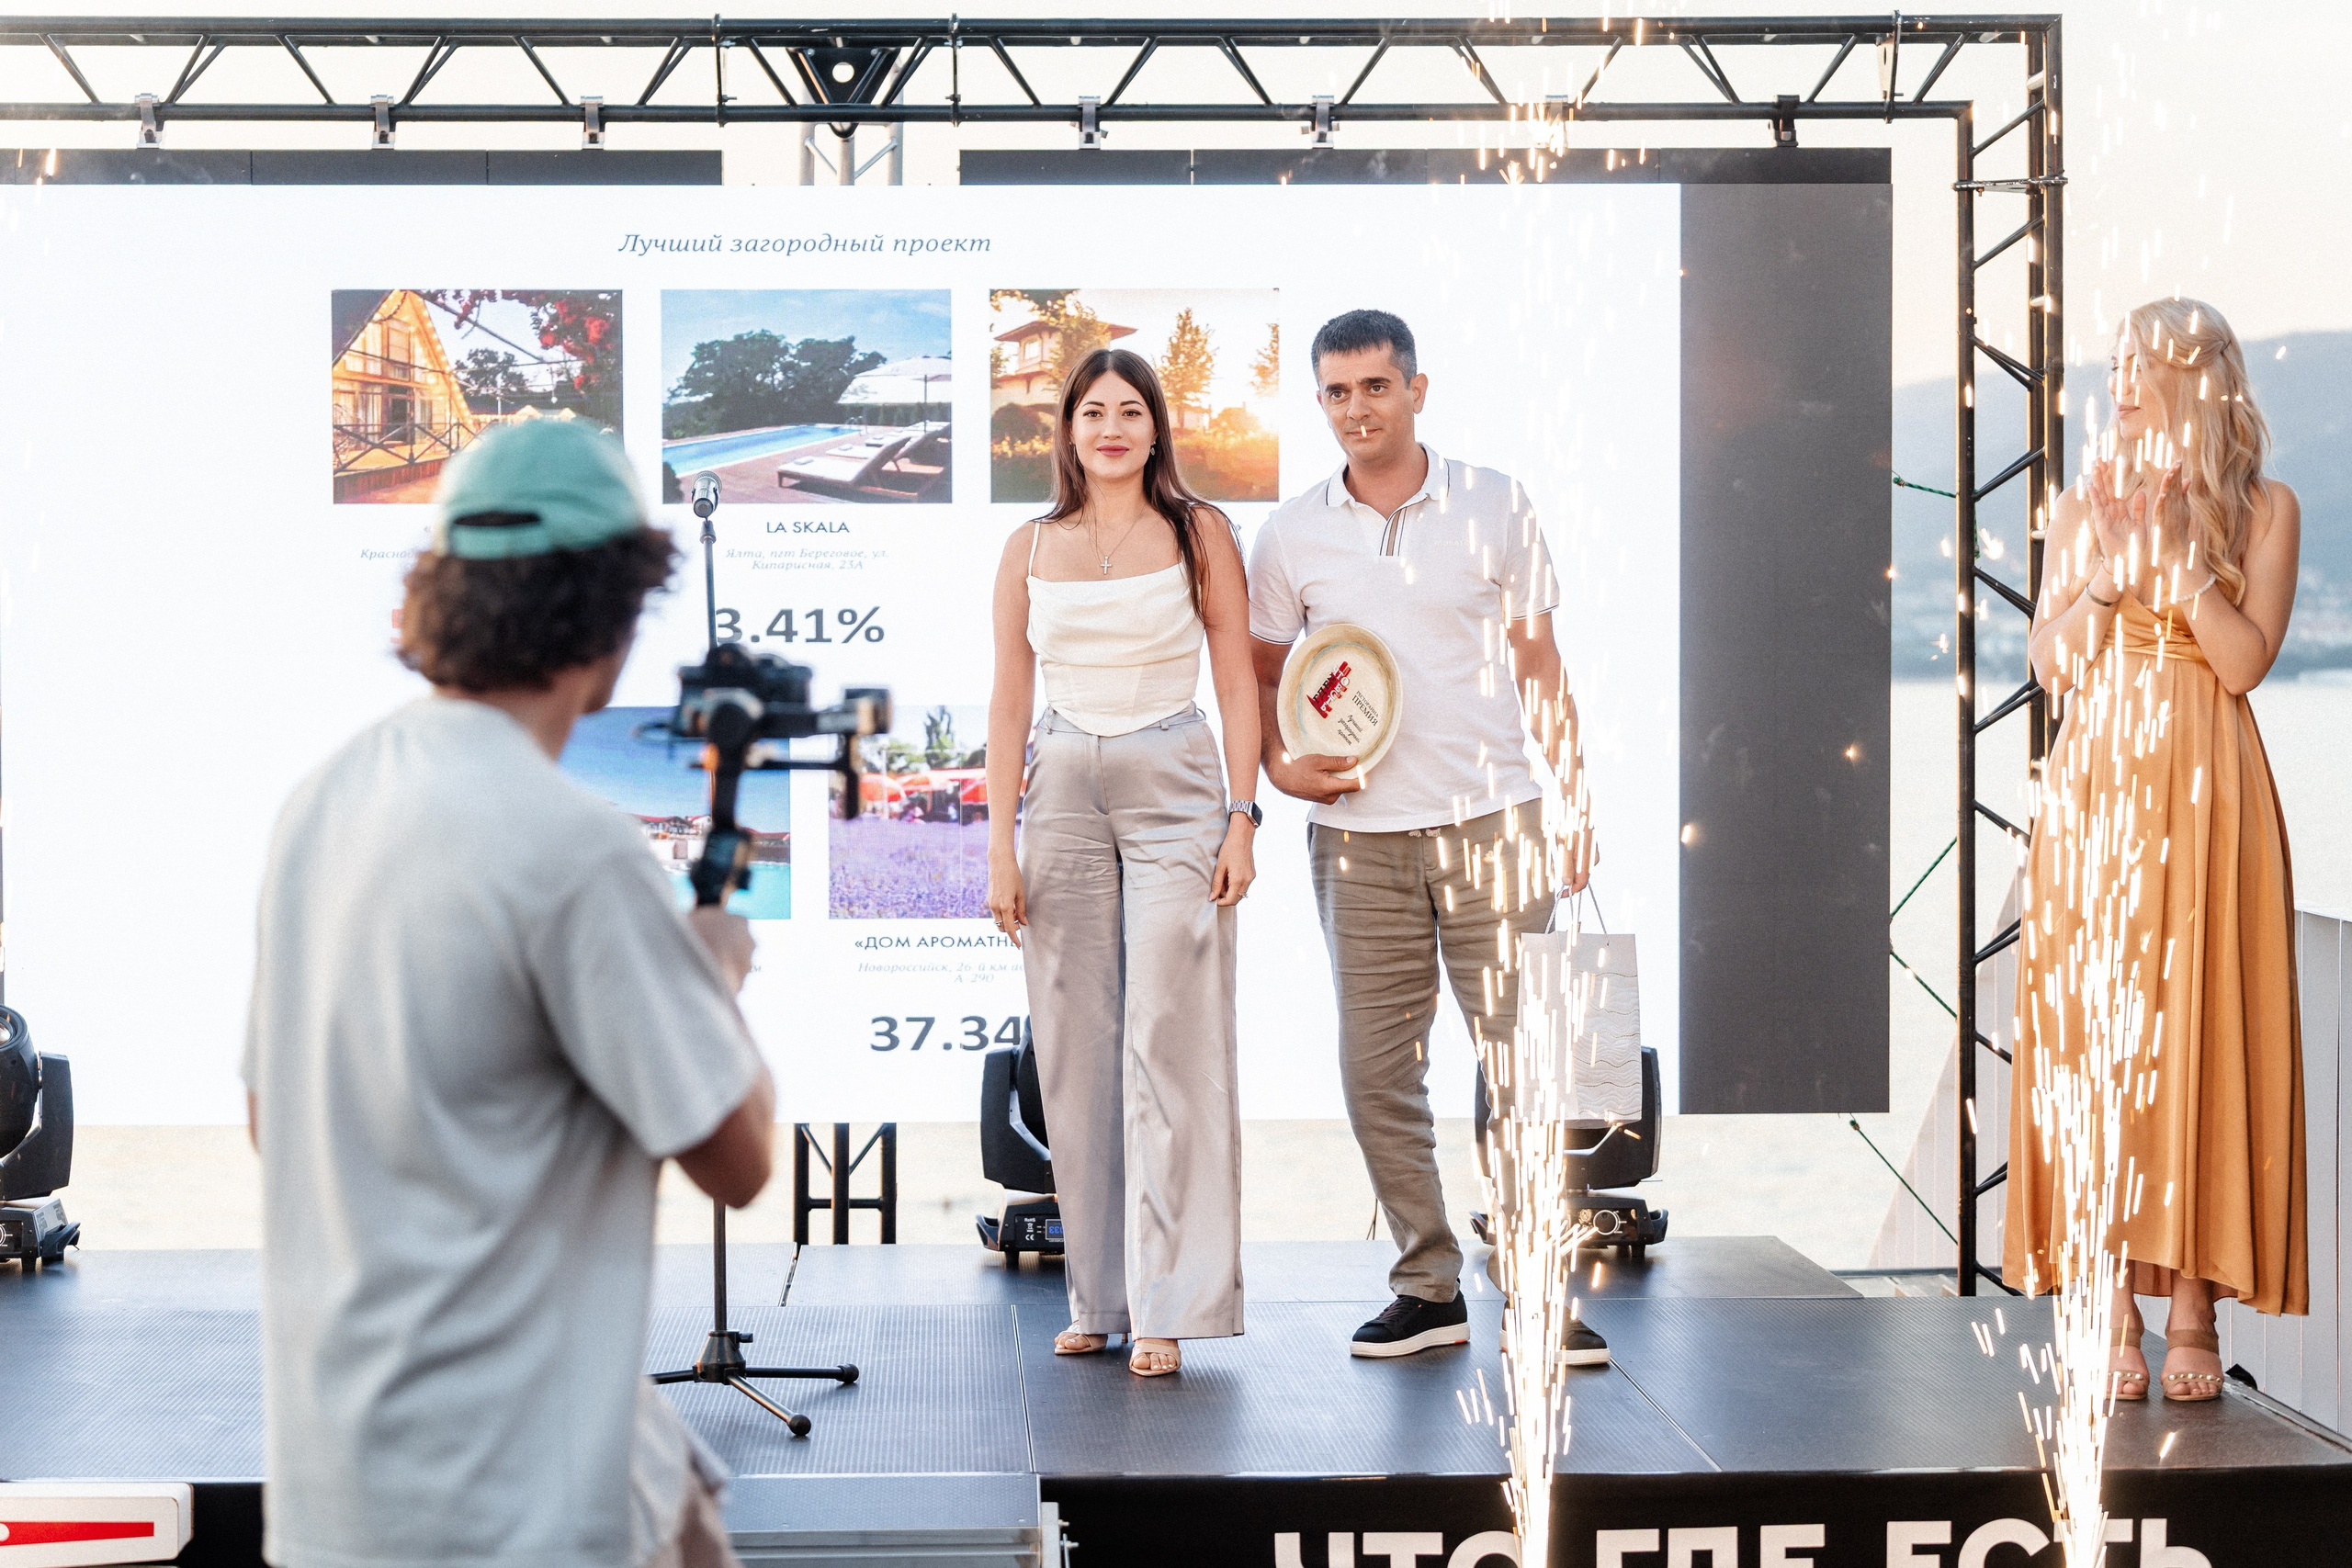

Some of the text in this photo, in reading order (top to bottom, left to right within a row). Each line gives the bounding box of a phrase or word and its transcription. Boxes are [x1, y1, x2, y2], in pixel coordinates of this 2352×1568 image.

[618, 233, 991, 256] Лучший загородный проект
[766, 521, 850, 534] LA SKALA
[799, 547, 867, 560] Береговое,
[716, 606, 885, 644] 3.41%
[1352, 694, 1378, 727] ПРЕМИЯ
[854, 936, 911, 951] «ДОМ
[1886, 1517, 2214, 1568] ЕСЬ
